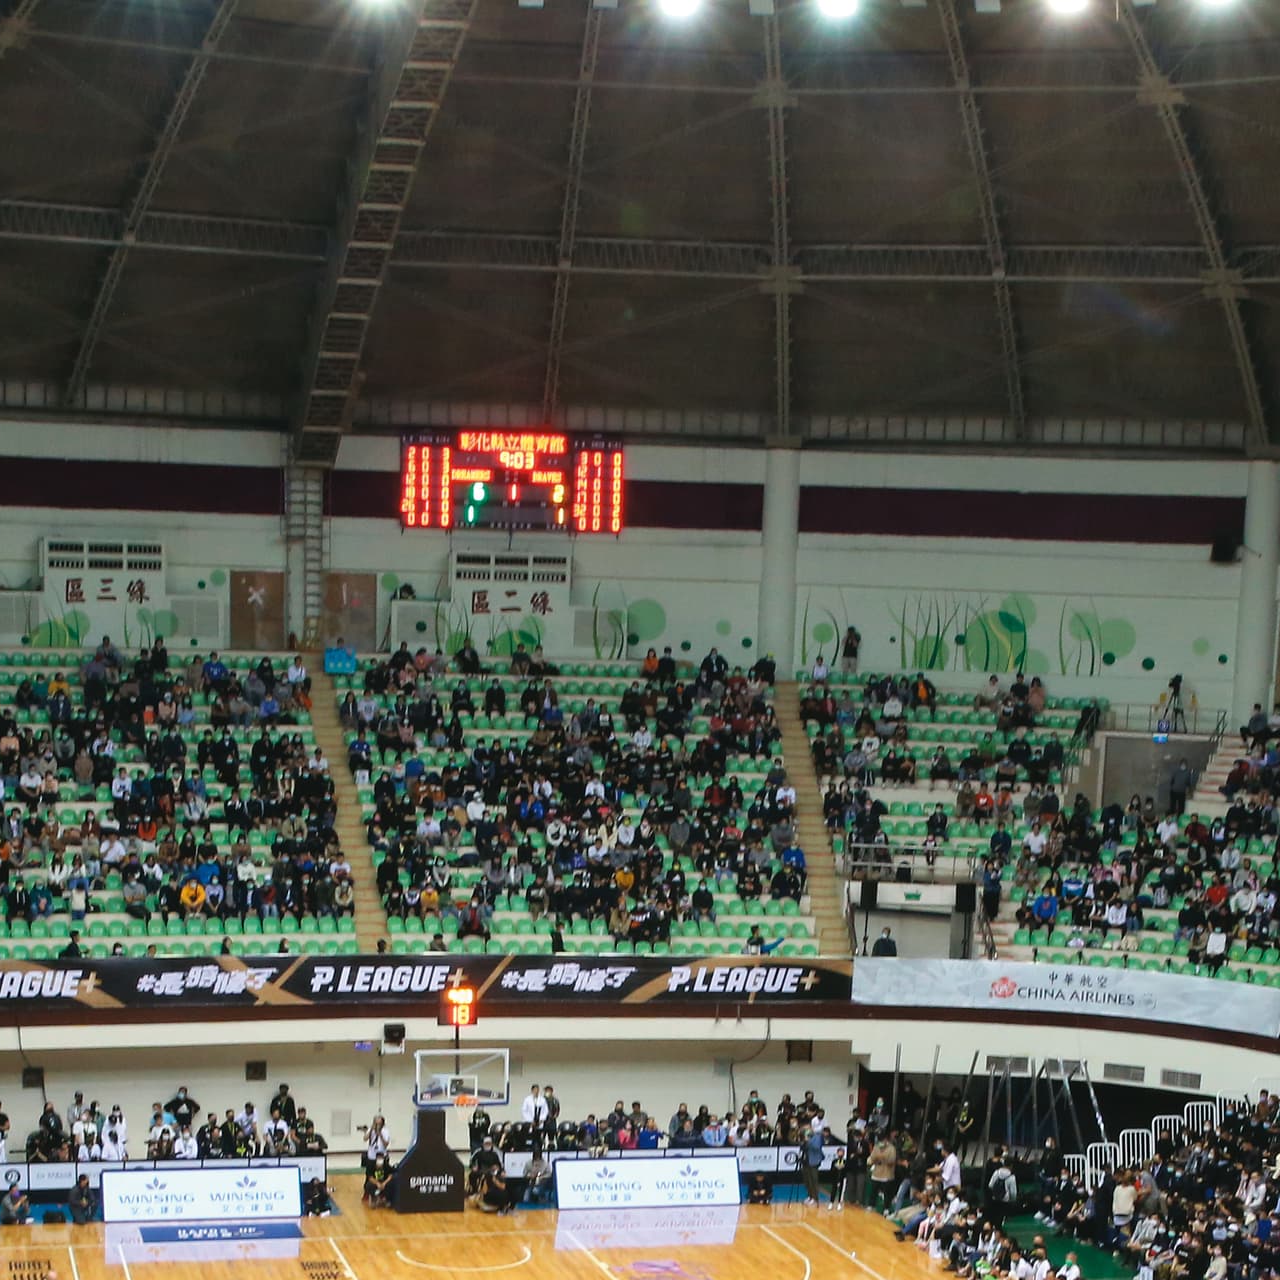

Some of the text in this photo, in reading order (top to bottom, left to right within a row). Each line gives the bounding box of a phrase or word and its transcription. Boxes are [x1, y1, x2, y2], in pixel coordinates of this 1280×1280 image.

[500, 452, 535, 469] 9:03
[1047, 970, 1109, 989] 中華航空
[1017, 986, 1136, 1008] CHINA AIRLINES
[409, 1173, 454, 1189] gamania
[571, 1181, 643, 1193] WINSING
[656, 1179, 726, 1190] WINSING
[118, 1193, 196, 1205] WINSING
[209, 1190, 286, 1202] WINSING
